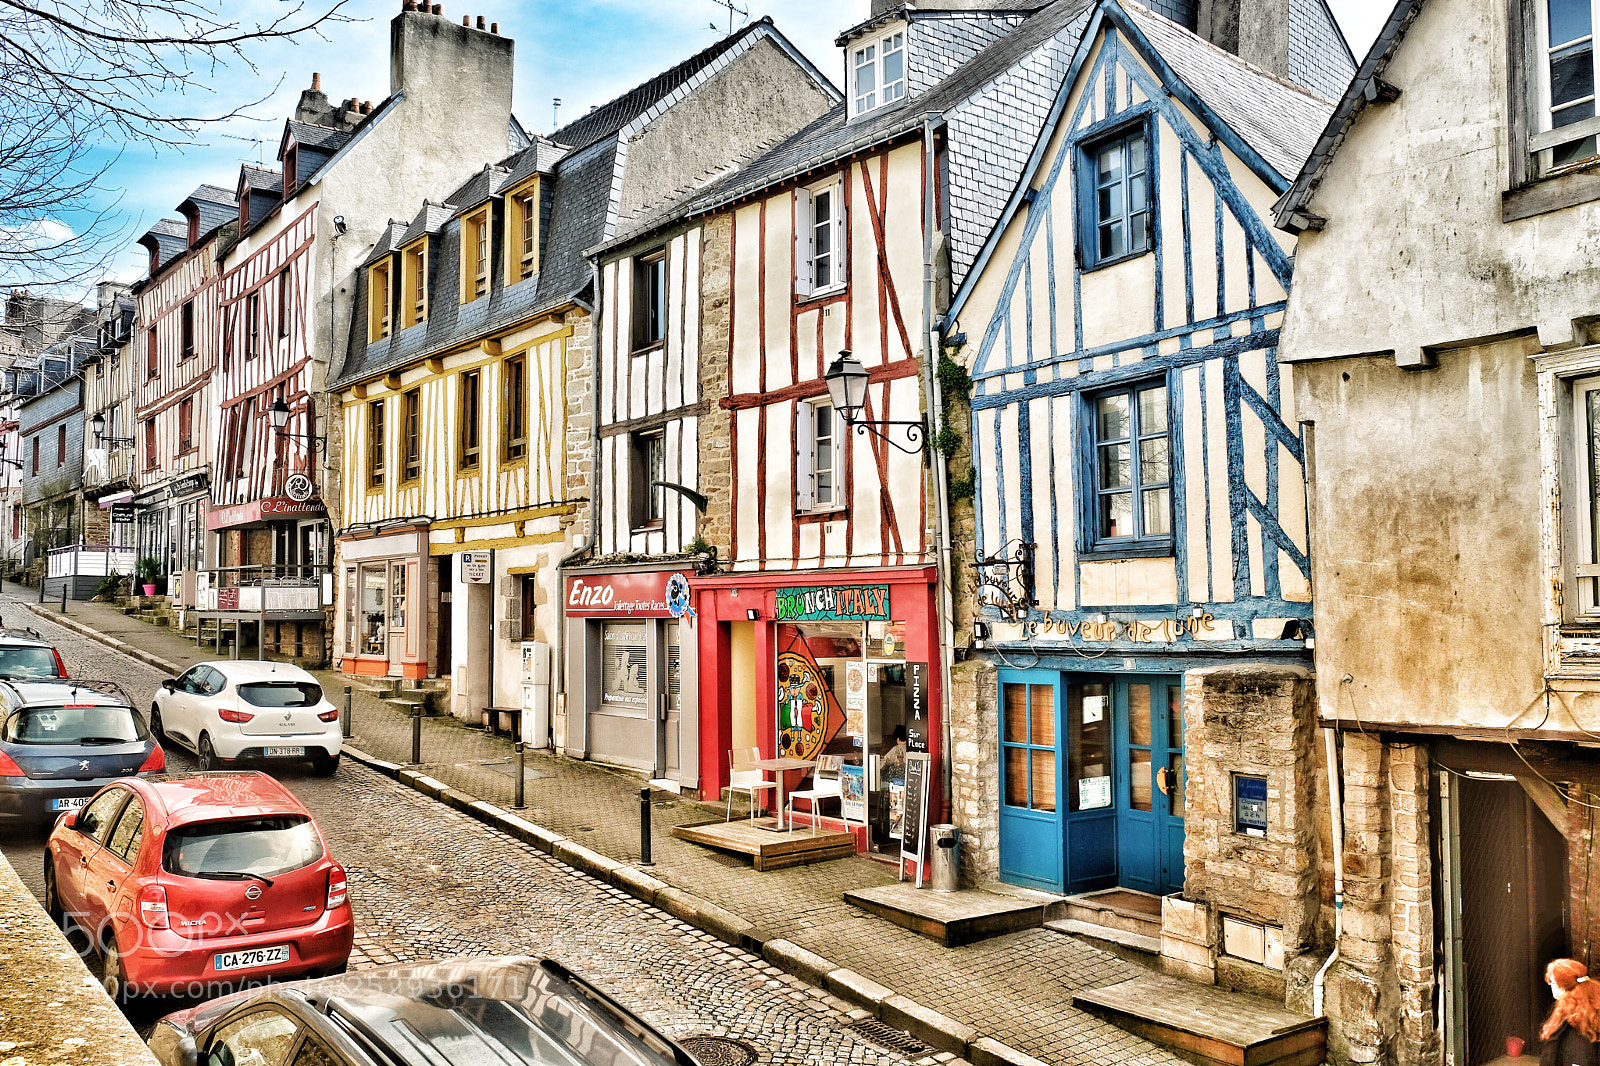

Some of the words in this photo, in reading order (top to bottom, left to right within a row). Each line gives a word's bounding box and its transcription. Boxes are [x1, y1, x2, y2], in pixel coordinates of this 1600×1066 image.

[569, 579, 614, 606] Enzo
[614, 600, 635, 614] Toilettage
[635, 599, 650, 611] Toutes
[1043, 611, 1117, 640] buveur
[1127, 620, 1152, 643] de
[913, 664, 921, 720] PIZZA
[908, 729, 920, 738] Sur
[223, 948, 282, 967] CA-276-ZZ
